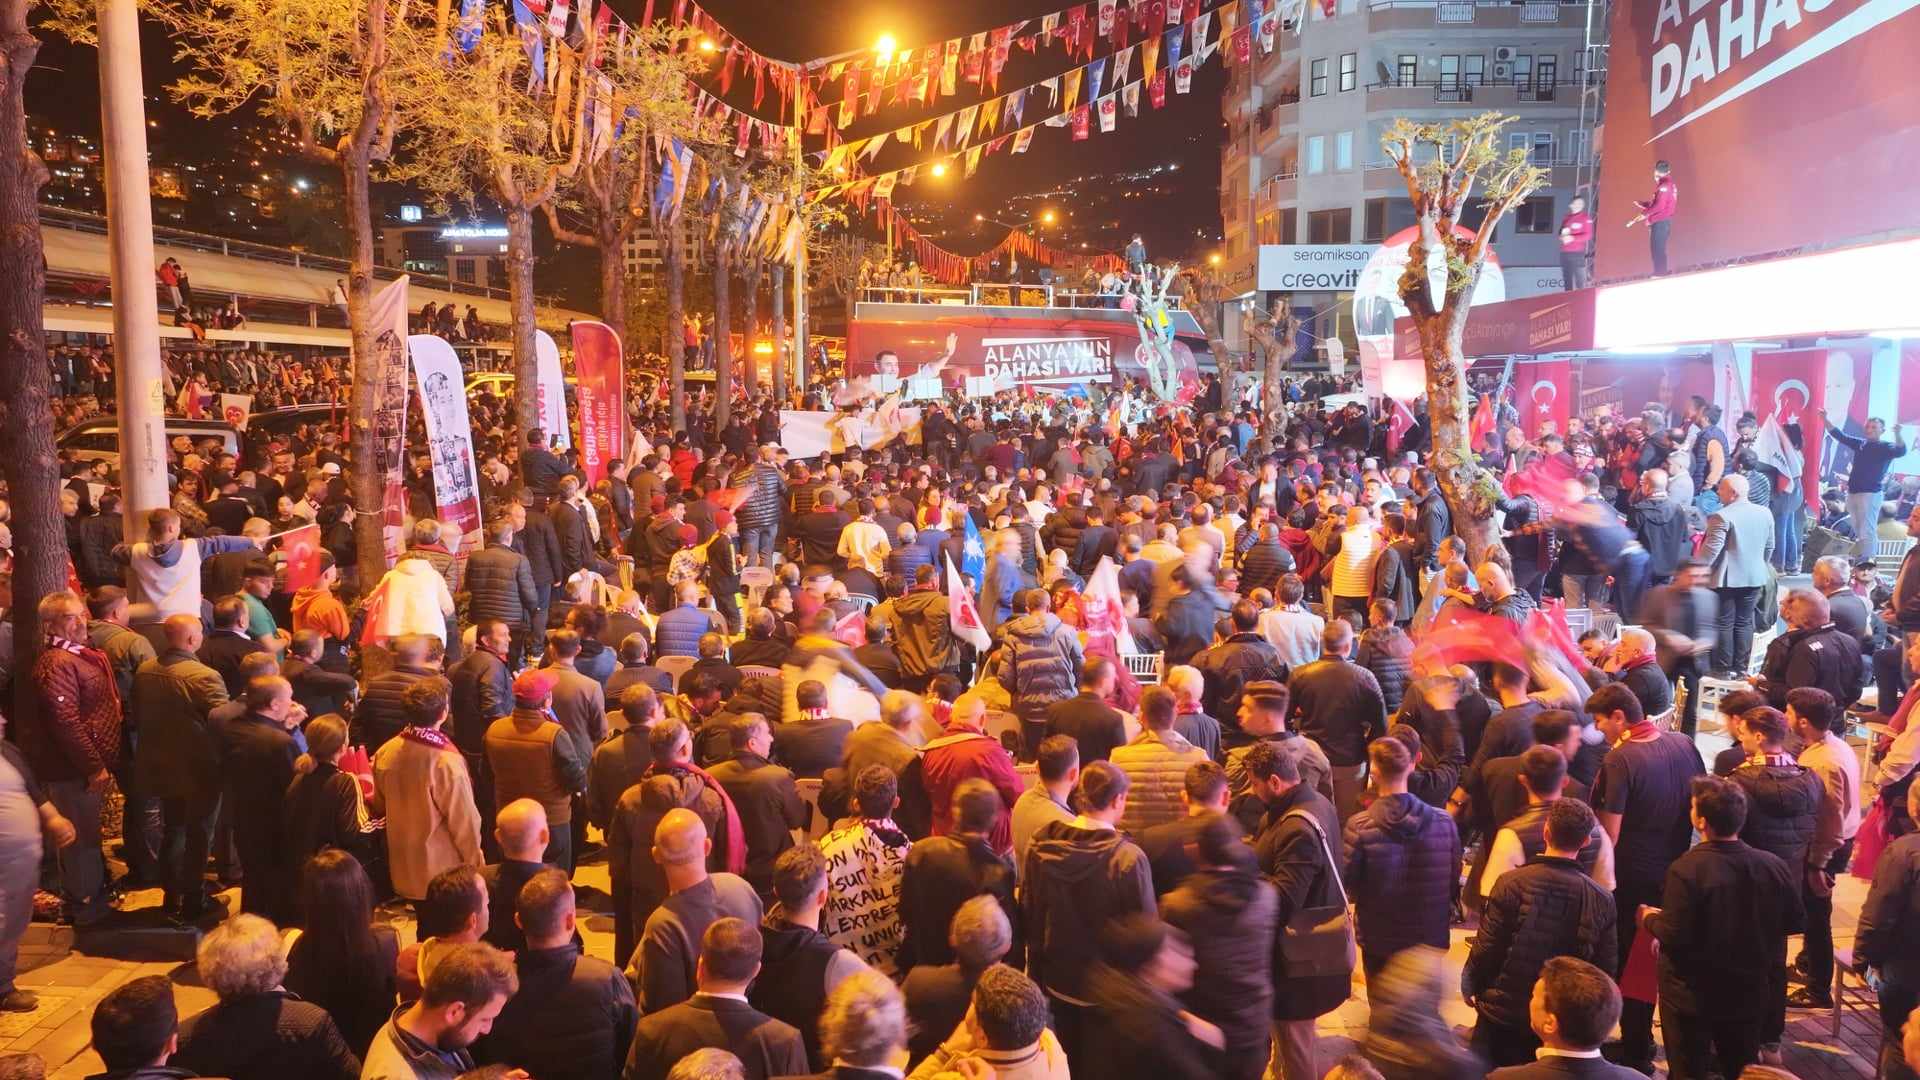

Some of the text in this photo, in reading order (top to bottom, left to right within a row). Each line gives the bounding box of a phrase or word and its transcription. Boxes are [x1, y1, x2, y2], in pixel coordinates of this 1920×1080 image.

[1651, 0, 1834, 117] DAHA
[1294, 248, 1369, 261] seramiksan
[984, 340, 1111, 363] ALANYA'NIN
[984, 356, 1111, 379] DAHASI VAR!
